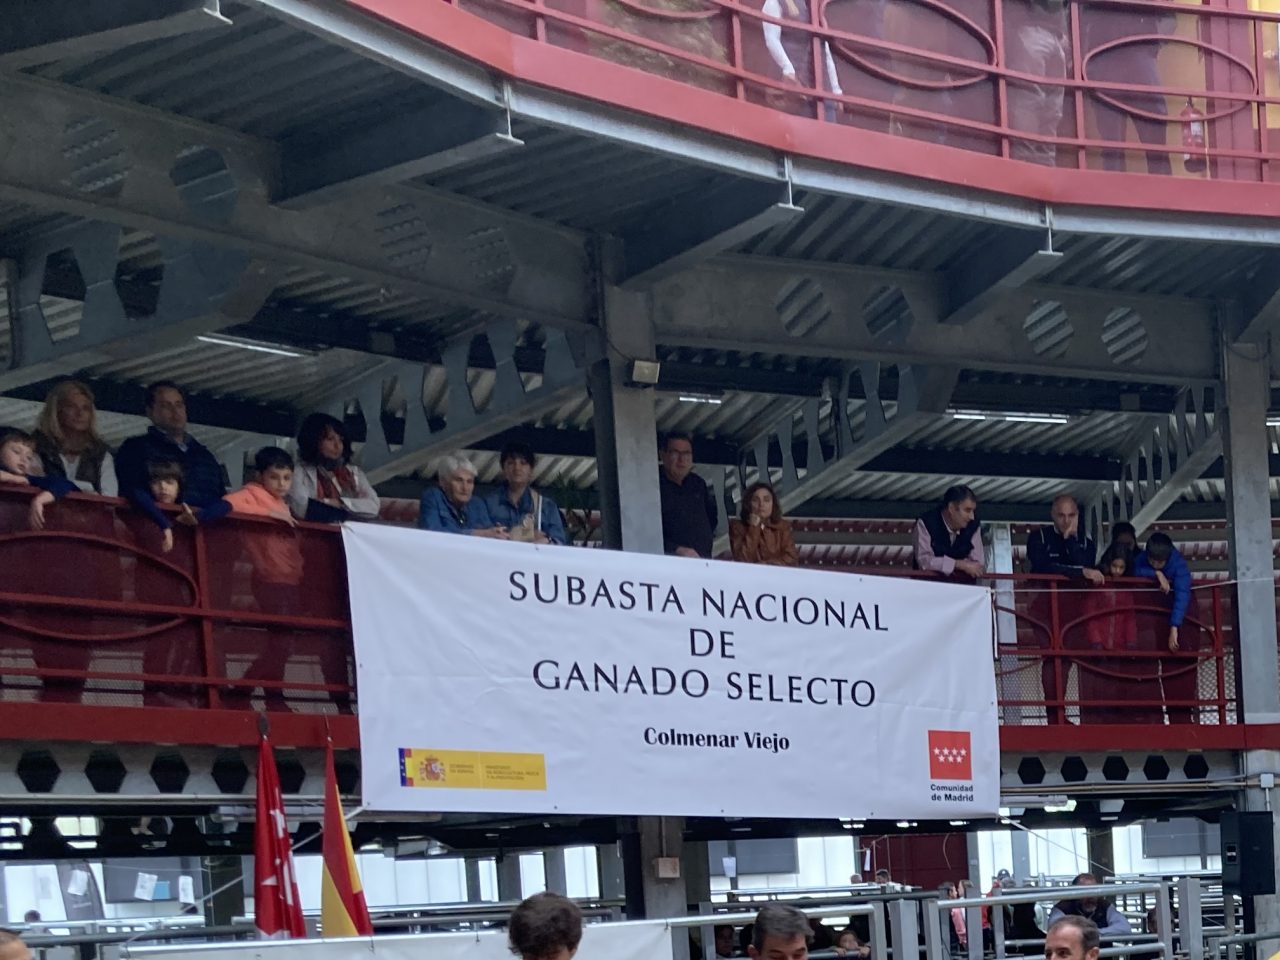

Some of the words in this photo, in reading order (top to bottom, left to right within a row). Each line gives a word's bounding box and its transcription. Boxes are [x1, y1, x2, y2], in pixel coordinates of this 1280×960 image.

[508, 570, 686, 616] SUBASTA
[701, 586, 889, 632] NACIONAL
[689, 627, 736, 660] DE
[532, 659, 710, 699] GANADO
[726, 671, 876, 708] SELECTO
[643, 726, 739, 750] Colmenar
[743, 730, 791, 754] Viejo
[930, 783, 974, 792] Comunidad
[931, 793, 942, 801] de
[944, 793, 975, 802] Madrid
